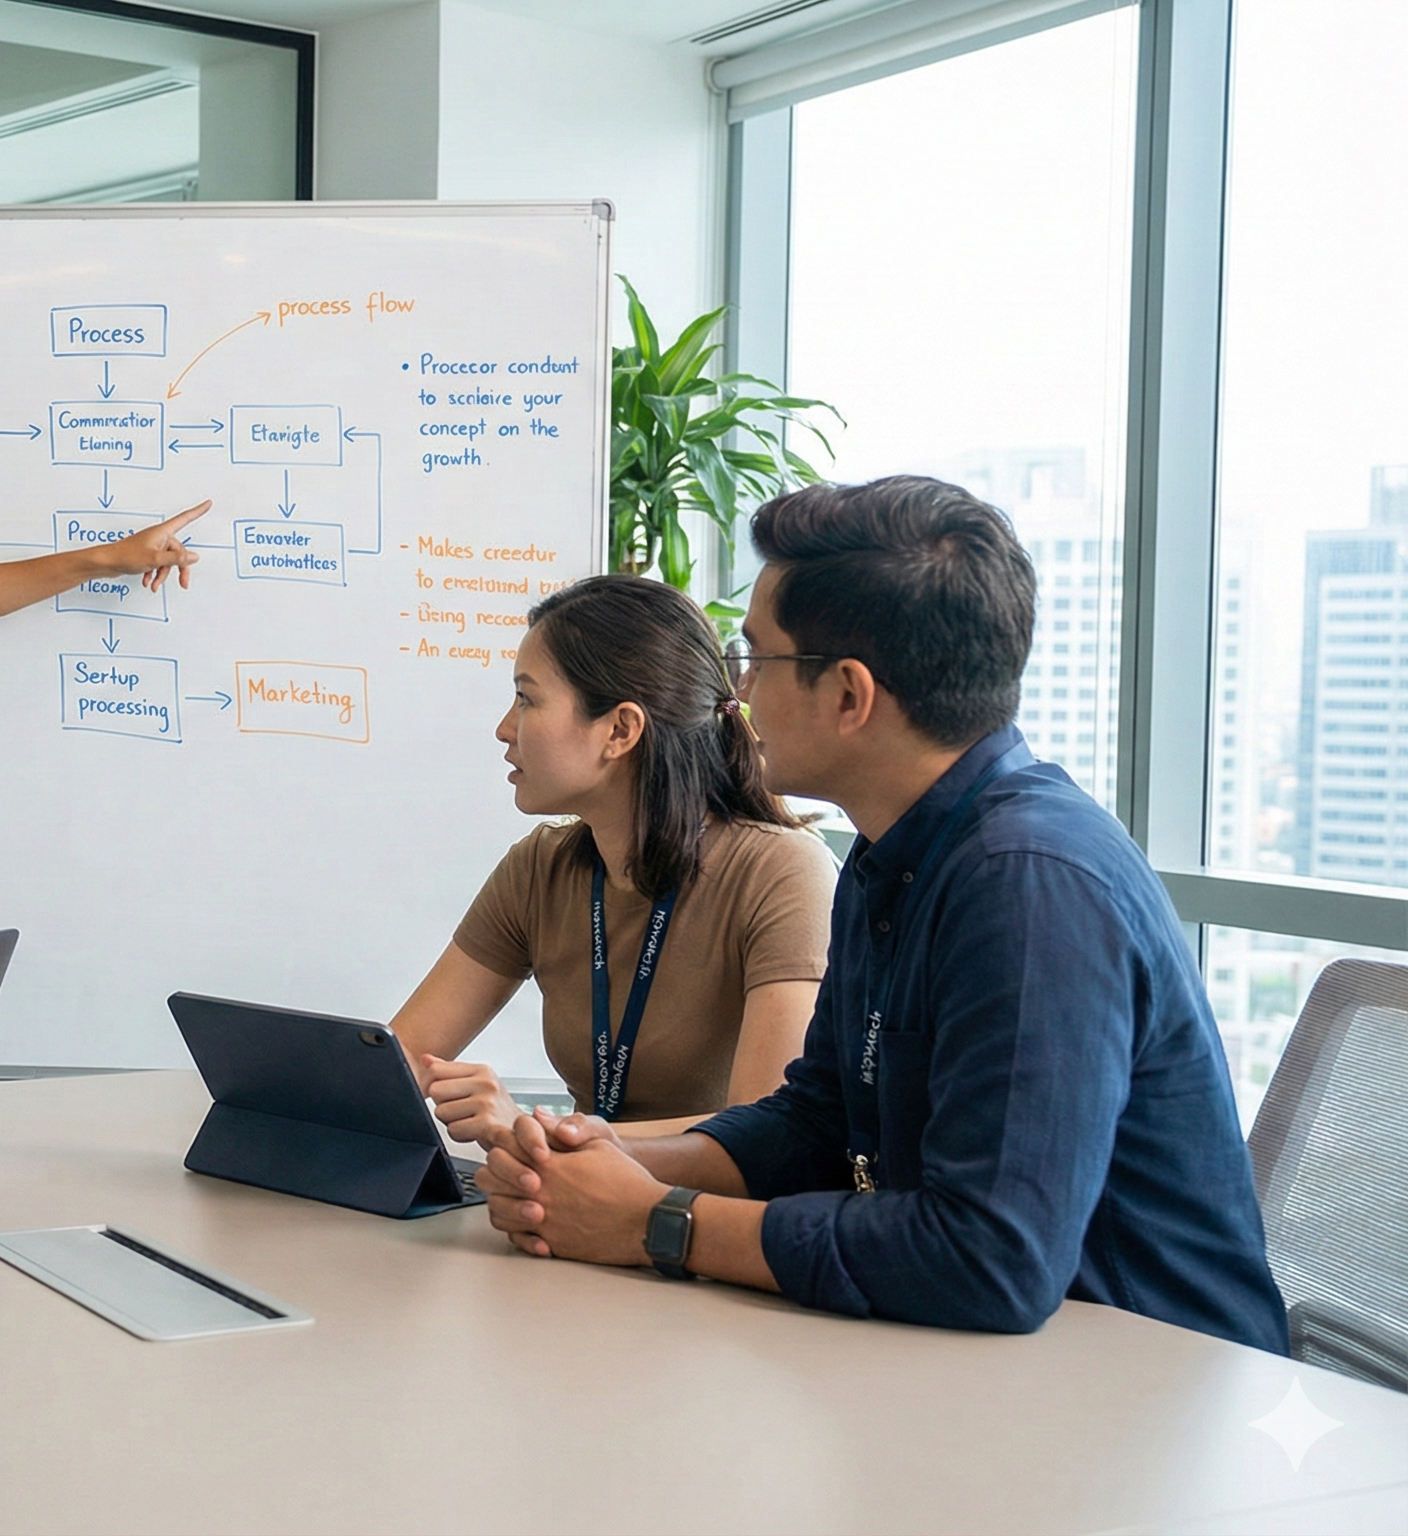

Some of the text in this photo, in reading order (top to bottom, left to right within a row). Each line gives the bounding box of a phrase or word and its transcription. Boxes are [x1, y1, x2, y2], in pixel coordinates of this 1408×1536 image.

[277, 291, 415, 327] process flow
[69, 317, 145, 344] Process
[418, 389, 437, 406] to
[523, 393, 563, 413] your
[419, 418, 559, 441] concept on the
[417, 535, 475, 560] Makes
[416, 567, 434, 589] to
[417, 637, 441, 657] An
[74, 661, 140, 691] Sertup
[247, 677, 354, 725] Marketing
[78, 697, 171, 734] processing
